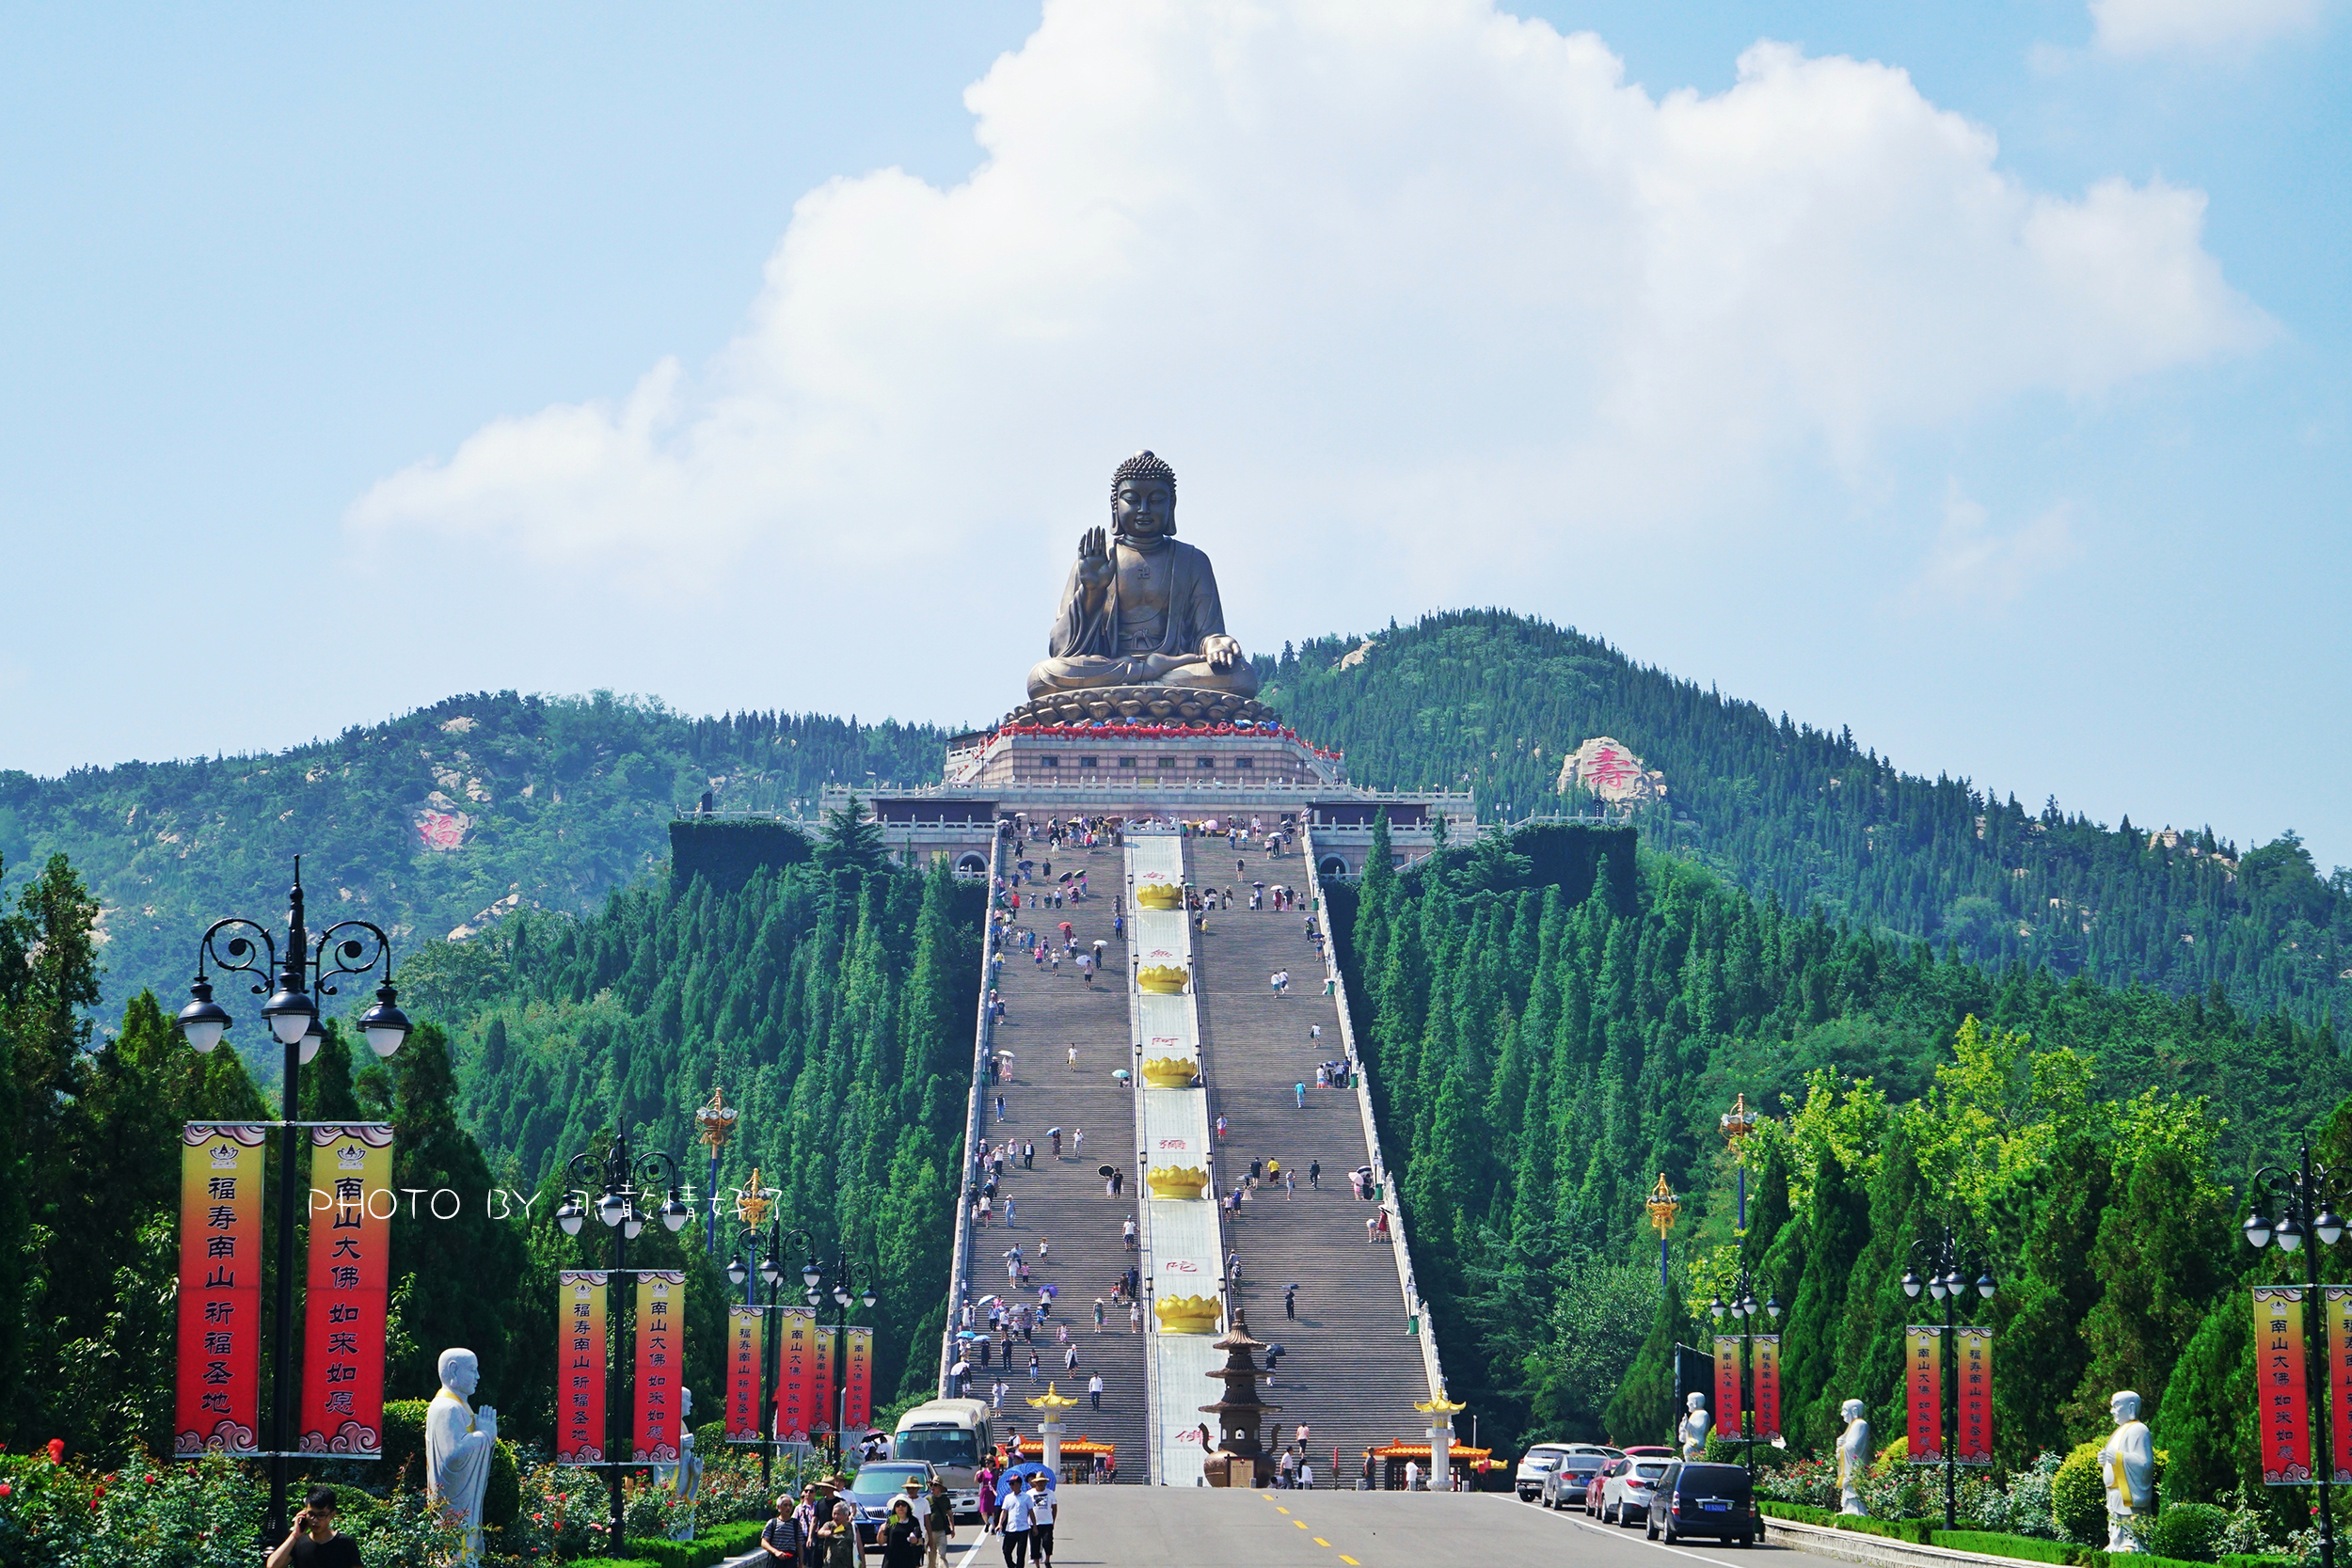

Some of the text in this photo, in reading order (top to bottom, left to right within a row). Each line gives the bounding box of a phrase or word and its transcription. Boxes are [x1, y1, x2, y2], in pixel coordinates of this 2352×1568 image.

[200, 1177, 237, 1415] 福寿南山祈福圣地
[325, 1176, 365, 1416] 南山大佛如来如愿
[571, 1302, 591, 1442] 福寿南山祈福圣地
[646, 1301, 669, 1441] 南山大佛如来如愿
[2269, 1319, 2296, 1461] 南山大佛如来如愿
